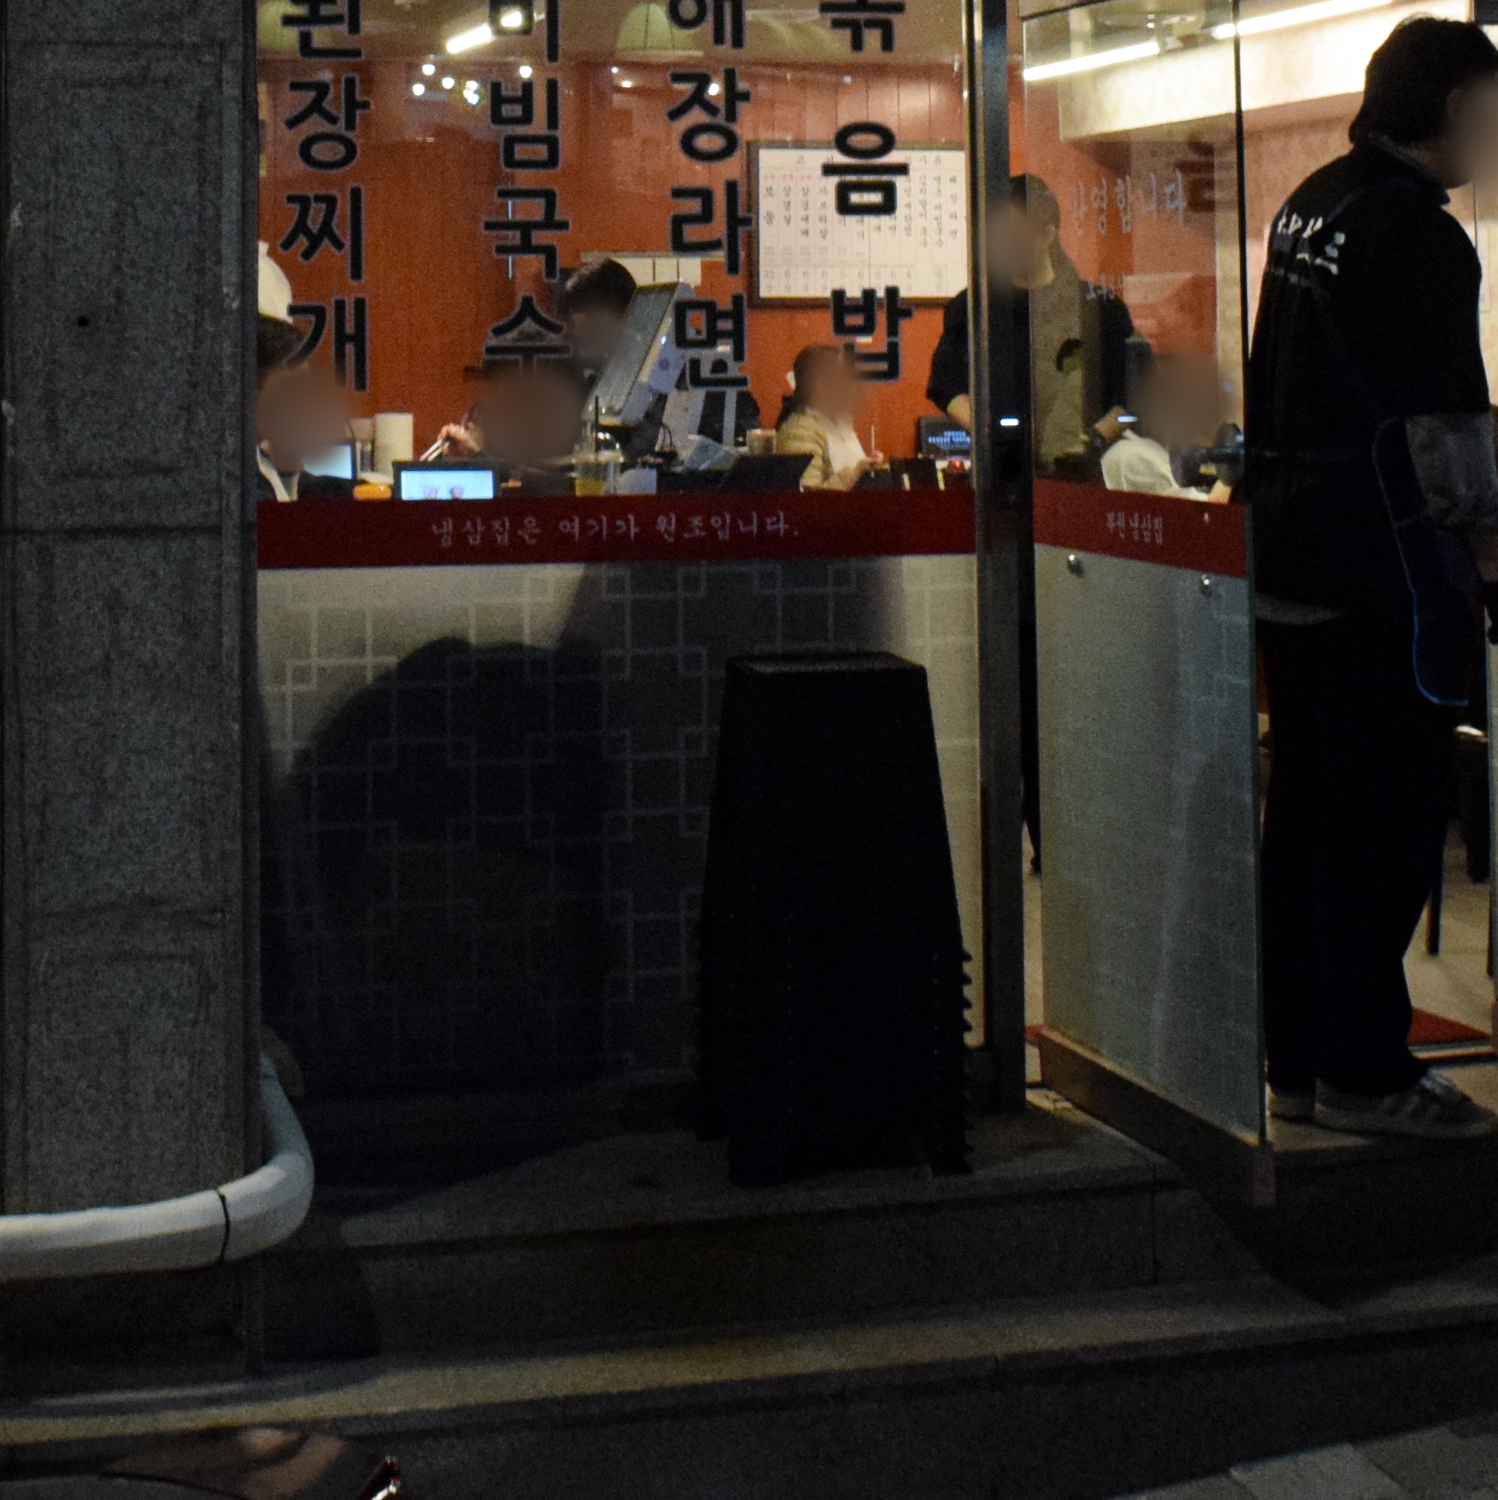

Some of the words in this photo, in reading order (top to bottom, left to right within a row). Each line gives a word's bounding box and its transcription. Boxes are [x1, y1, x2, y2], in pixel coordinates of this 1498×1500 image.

[431, 514, 542, 548] 냉삼집은
[558, 512, 640, 543] 여기가
[655, 510, 800, 544] 원조입니다.
